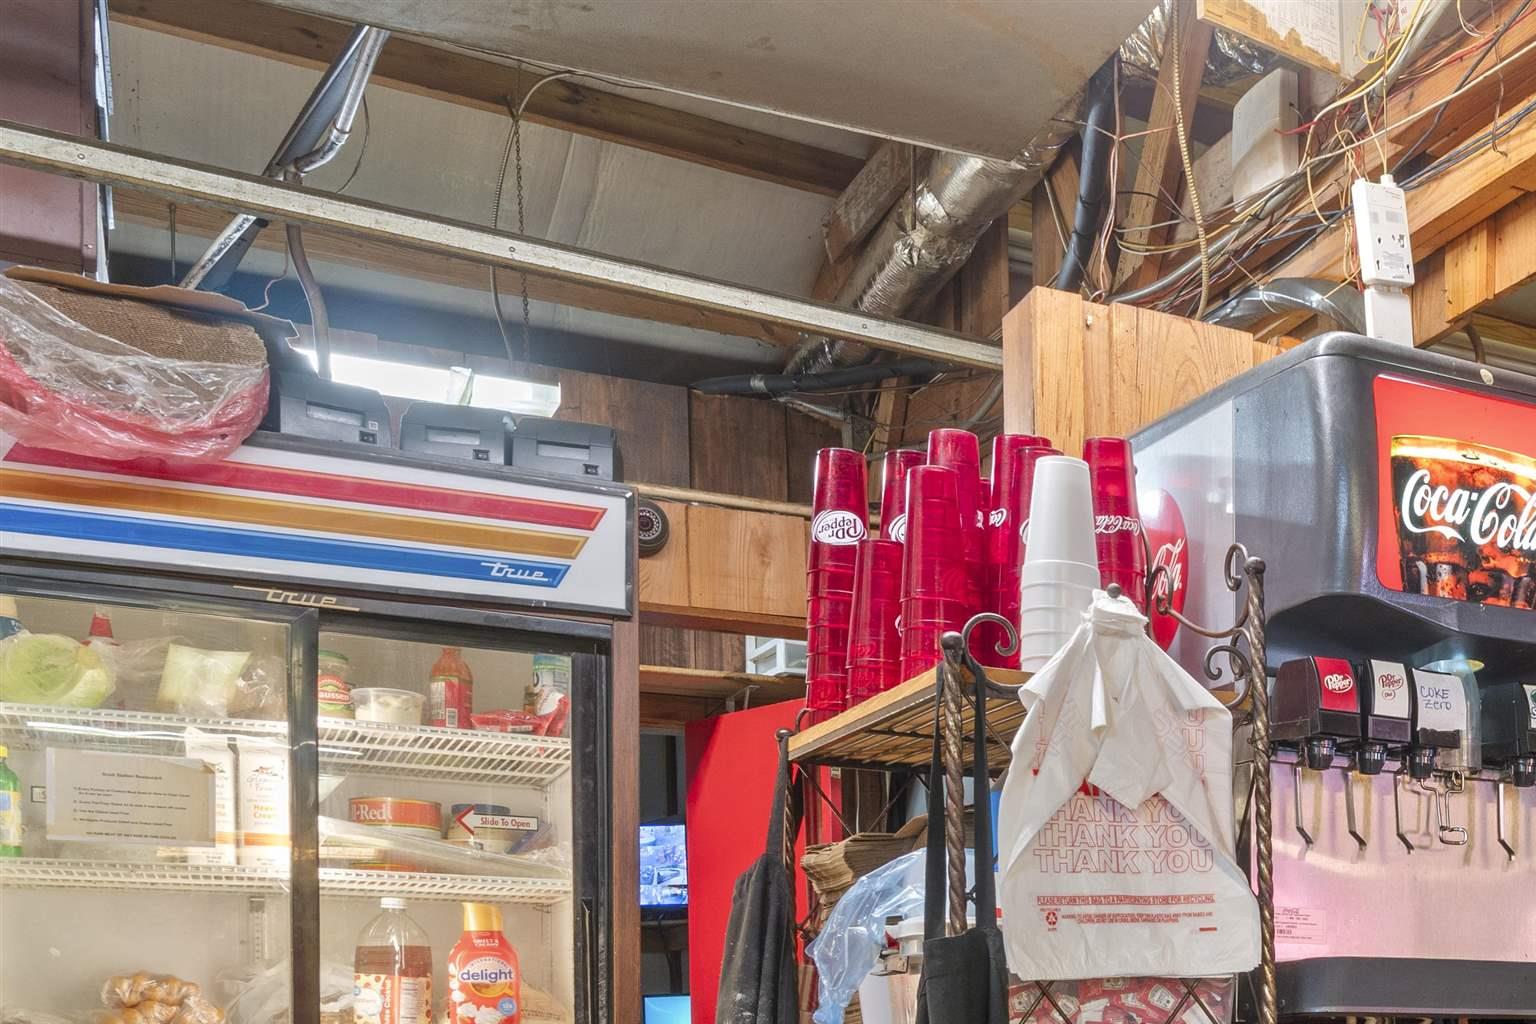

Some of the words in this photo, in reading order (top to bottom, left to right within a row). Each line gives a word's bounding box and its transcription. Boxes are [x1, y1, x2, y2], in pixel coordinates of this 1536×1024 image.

[819, 515, 859, 537] Pepper
[828, 528, 845, 539] Dr
[1095, 515, 1140, 536] Coca-Cola
[1325, 675, 1351, 690] Pepper
[1420, 686, 1449, 699] COKE
[480, 816, 500, 827] Slide
[501, 818, 510, 828] To
[511, 818, 531, 829] Open
[1036, 823, 1140, 848] THANK
[1033, 848, 1141, 873] THANK
[1143, 849, 1215, 874] YOU
[460, 968, 514, 984] delight
